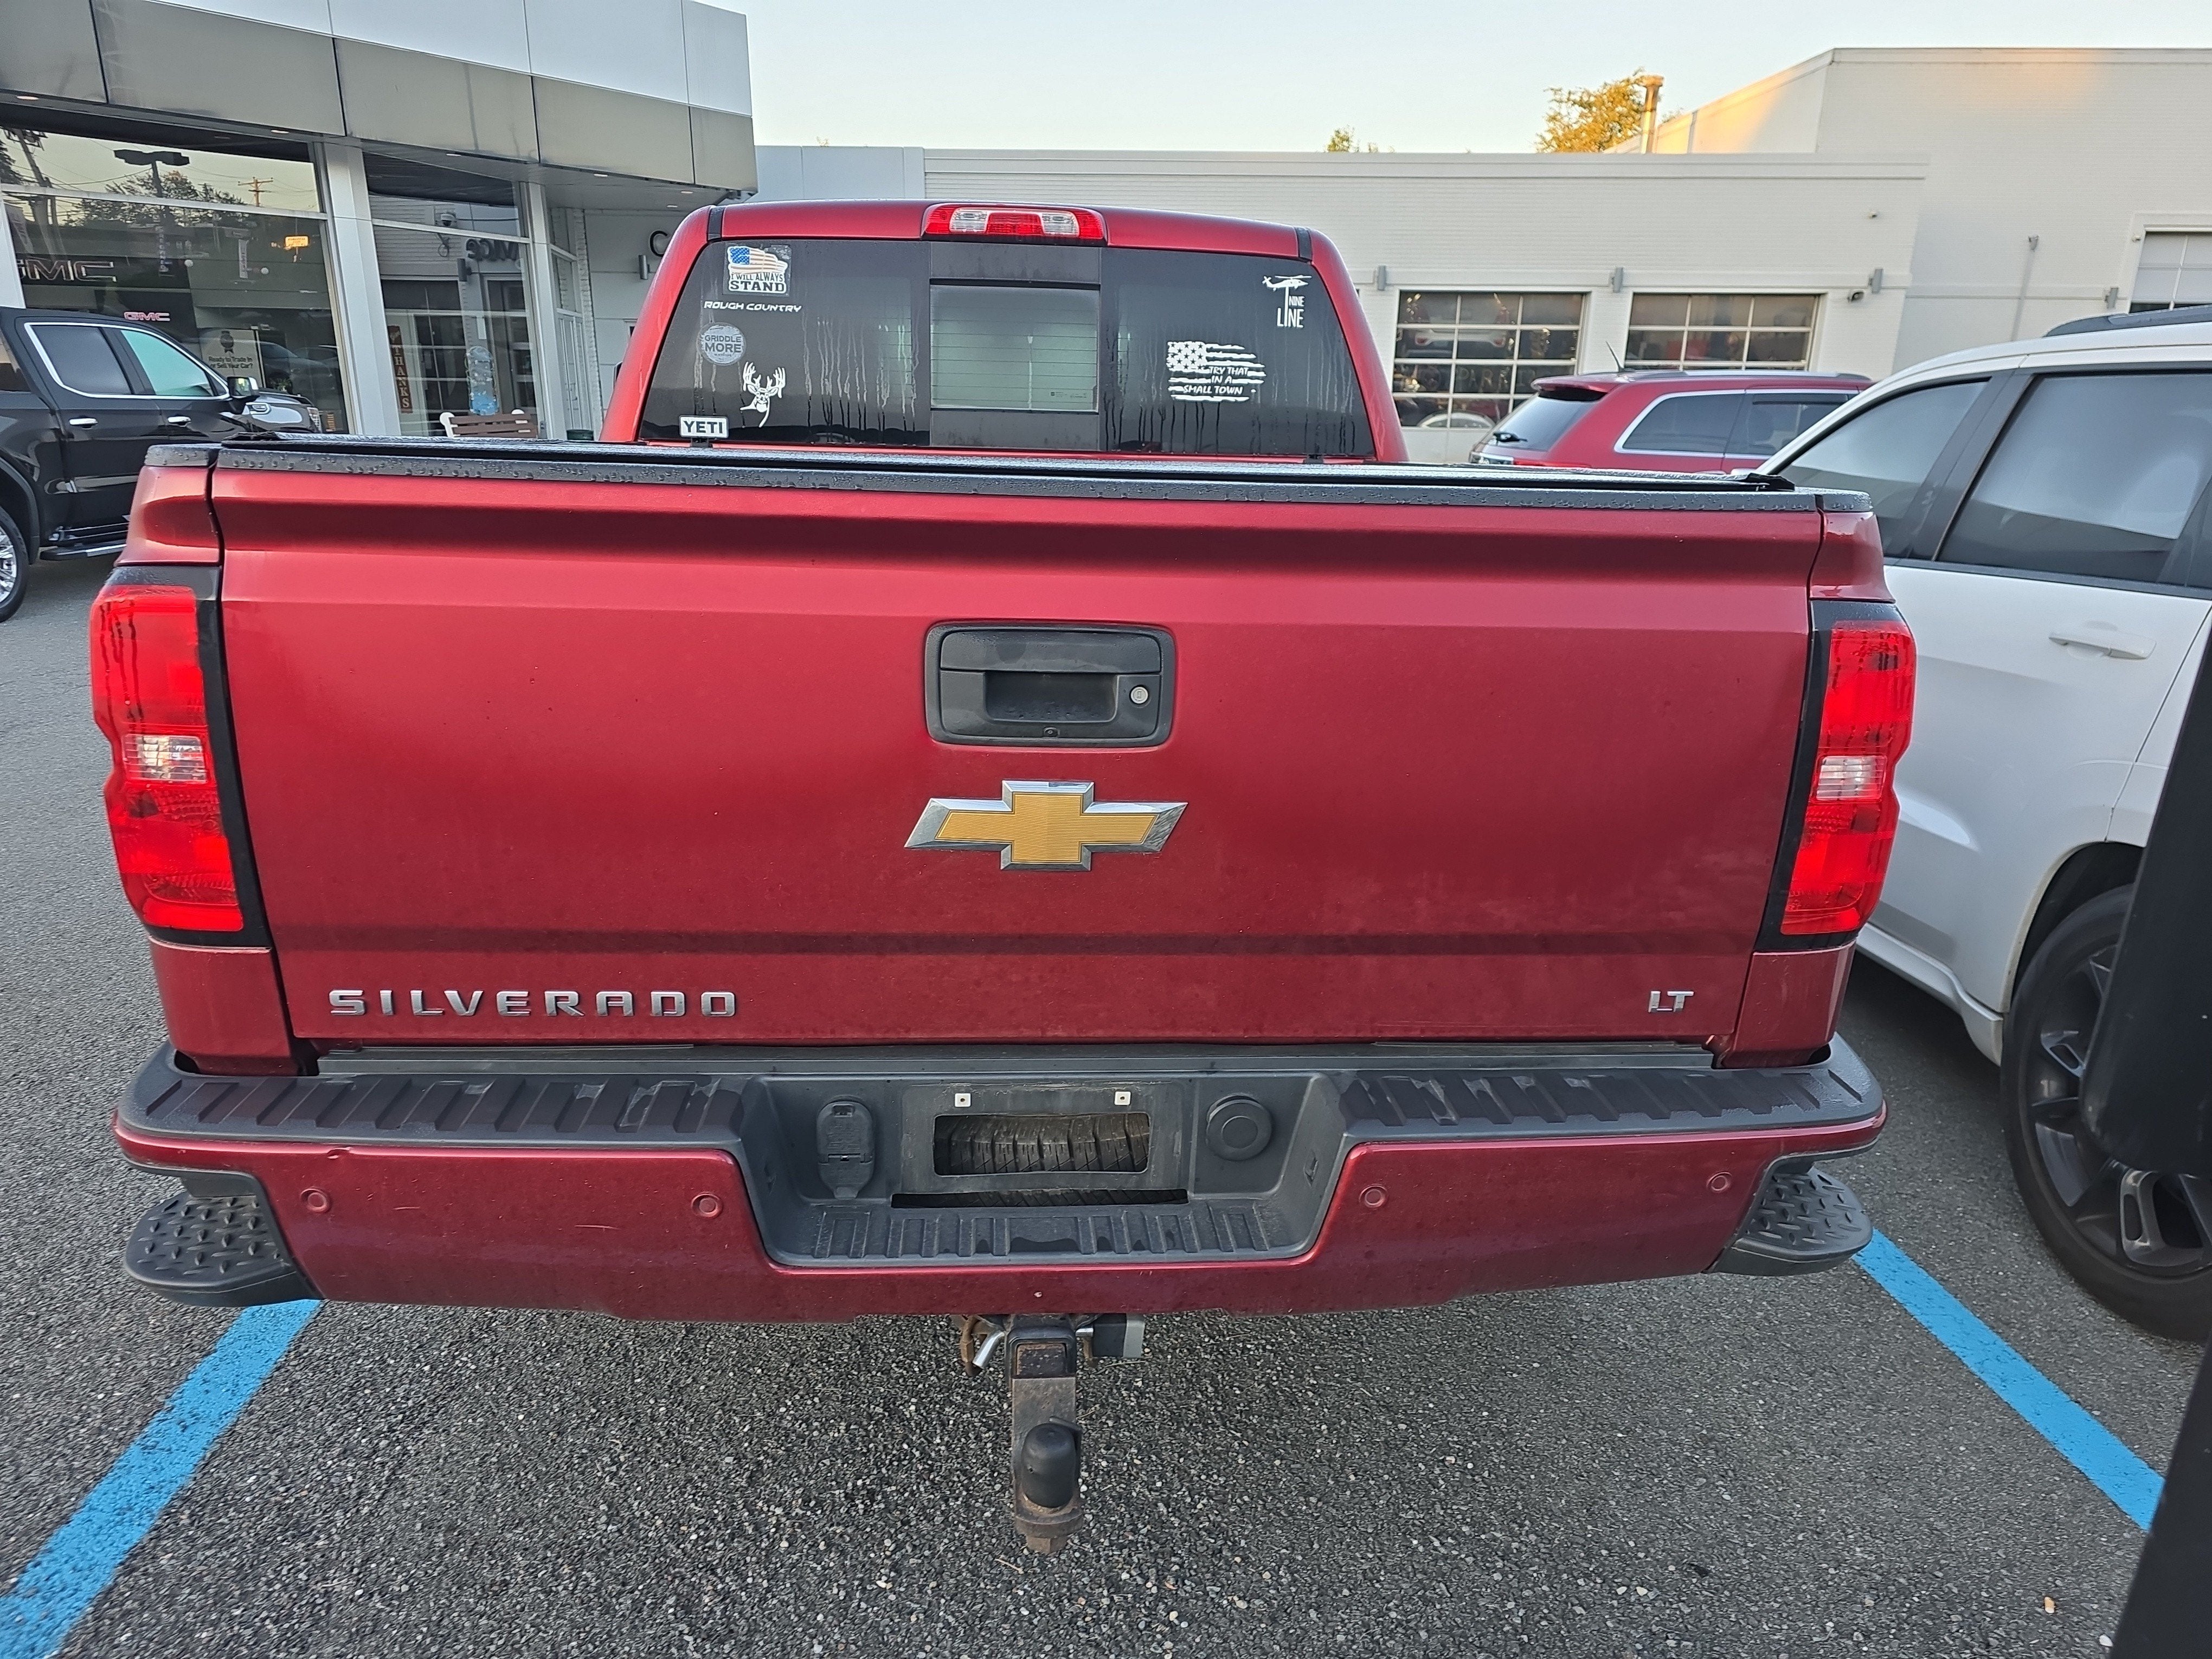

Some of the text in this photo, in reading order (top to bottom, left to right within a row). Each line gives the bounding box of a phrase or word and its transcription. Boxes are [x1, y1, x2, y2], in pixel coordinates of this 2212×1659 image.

[756, 272, 783, 282] ALWAYS
[730, 280, 785, 292] STAND
[704, 301, 802, 312] ROUGH COUNTRY
[1289, 295, 1305, 307] NINE
[124, 311, 171, 321] GMC
[1277, 307, 1304, 328] LINE
[705, 343, 742, 353] MORE
[1208, 366, 1249, 375] TRY THAT
[392, 345, 410, 408] THANKS
[1211, 375, 1232, 383] IN A
[1183, 384, 1243, 395] SMALL TOWN
[683, 420, 723, 434] YETI
[328, 989, 737, 1017] SILVERADO
[1648, 991, 1694, 1013] LT
